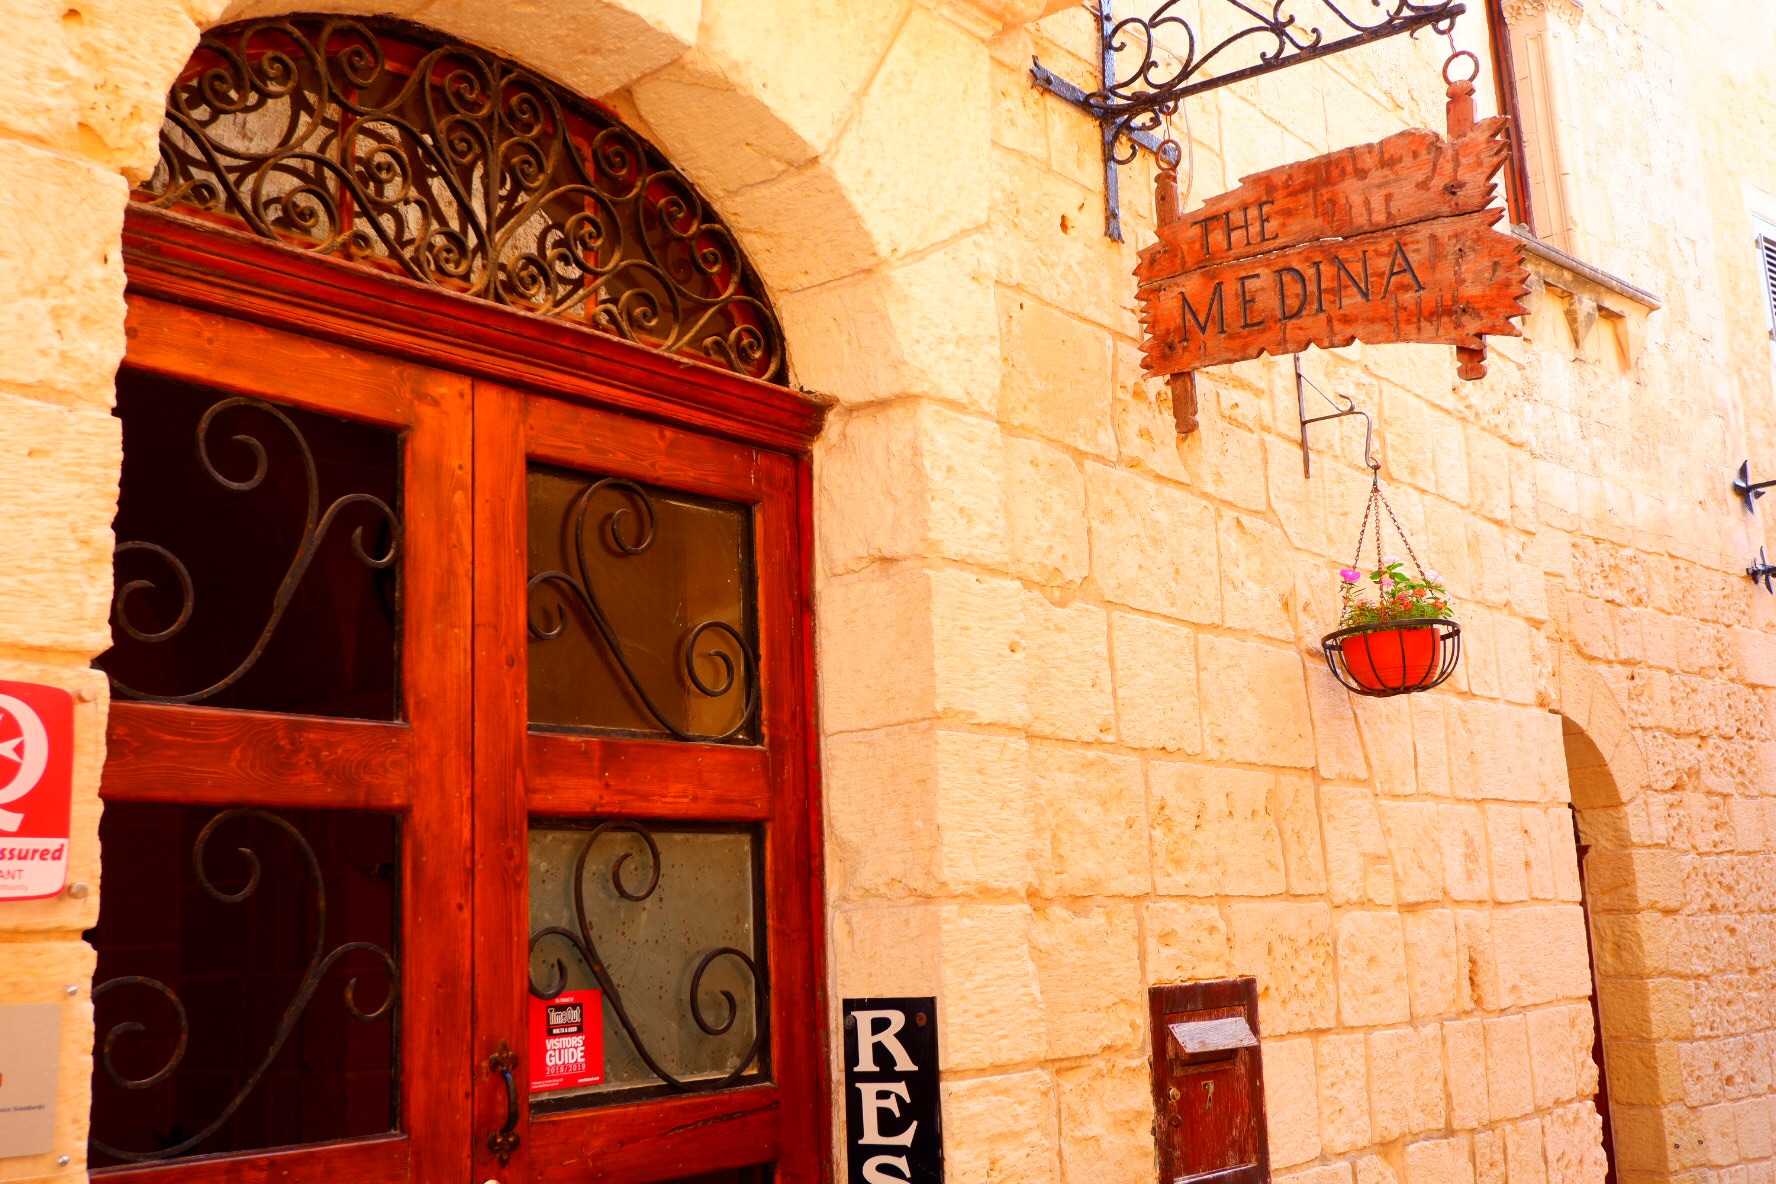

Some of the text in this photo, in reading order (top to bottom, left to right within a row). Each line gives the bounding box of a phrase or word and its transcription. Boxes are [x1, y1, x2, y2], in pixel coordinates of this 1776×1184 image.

[1191, 200, 1279, 256] THE
[1178, 240, 1425, 344] MEDINA
[546, 1035, 585, 1050] VISITORS'
[546, 1047, 585, 1066] GUIDE
[546, 1064, 586, 1075] 2018/2019
[1201, 1080, 1215, 1109] 7
